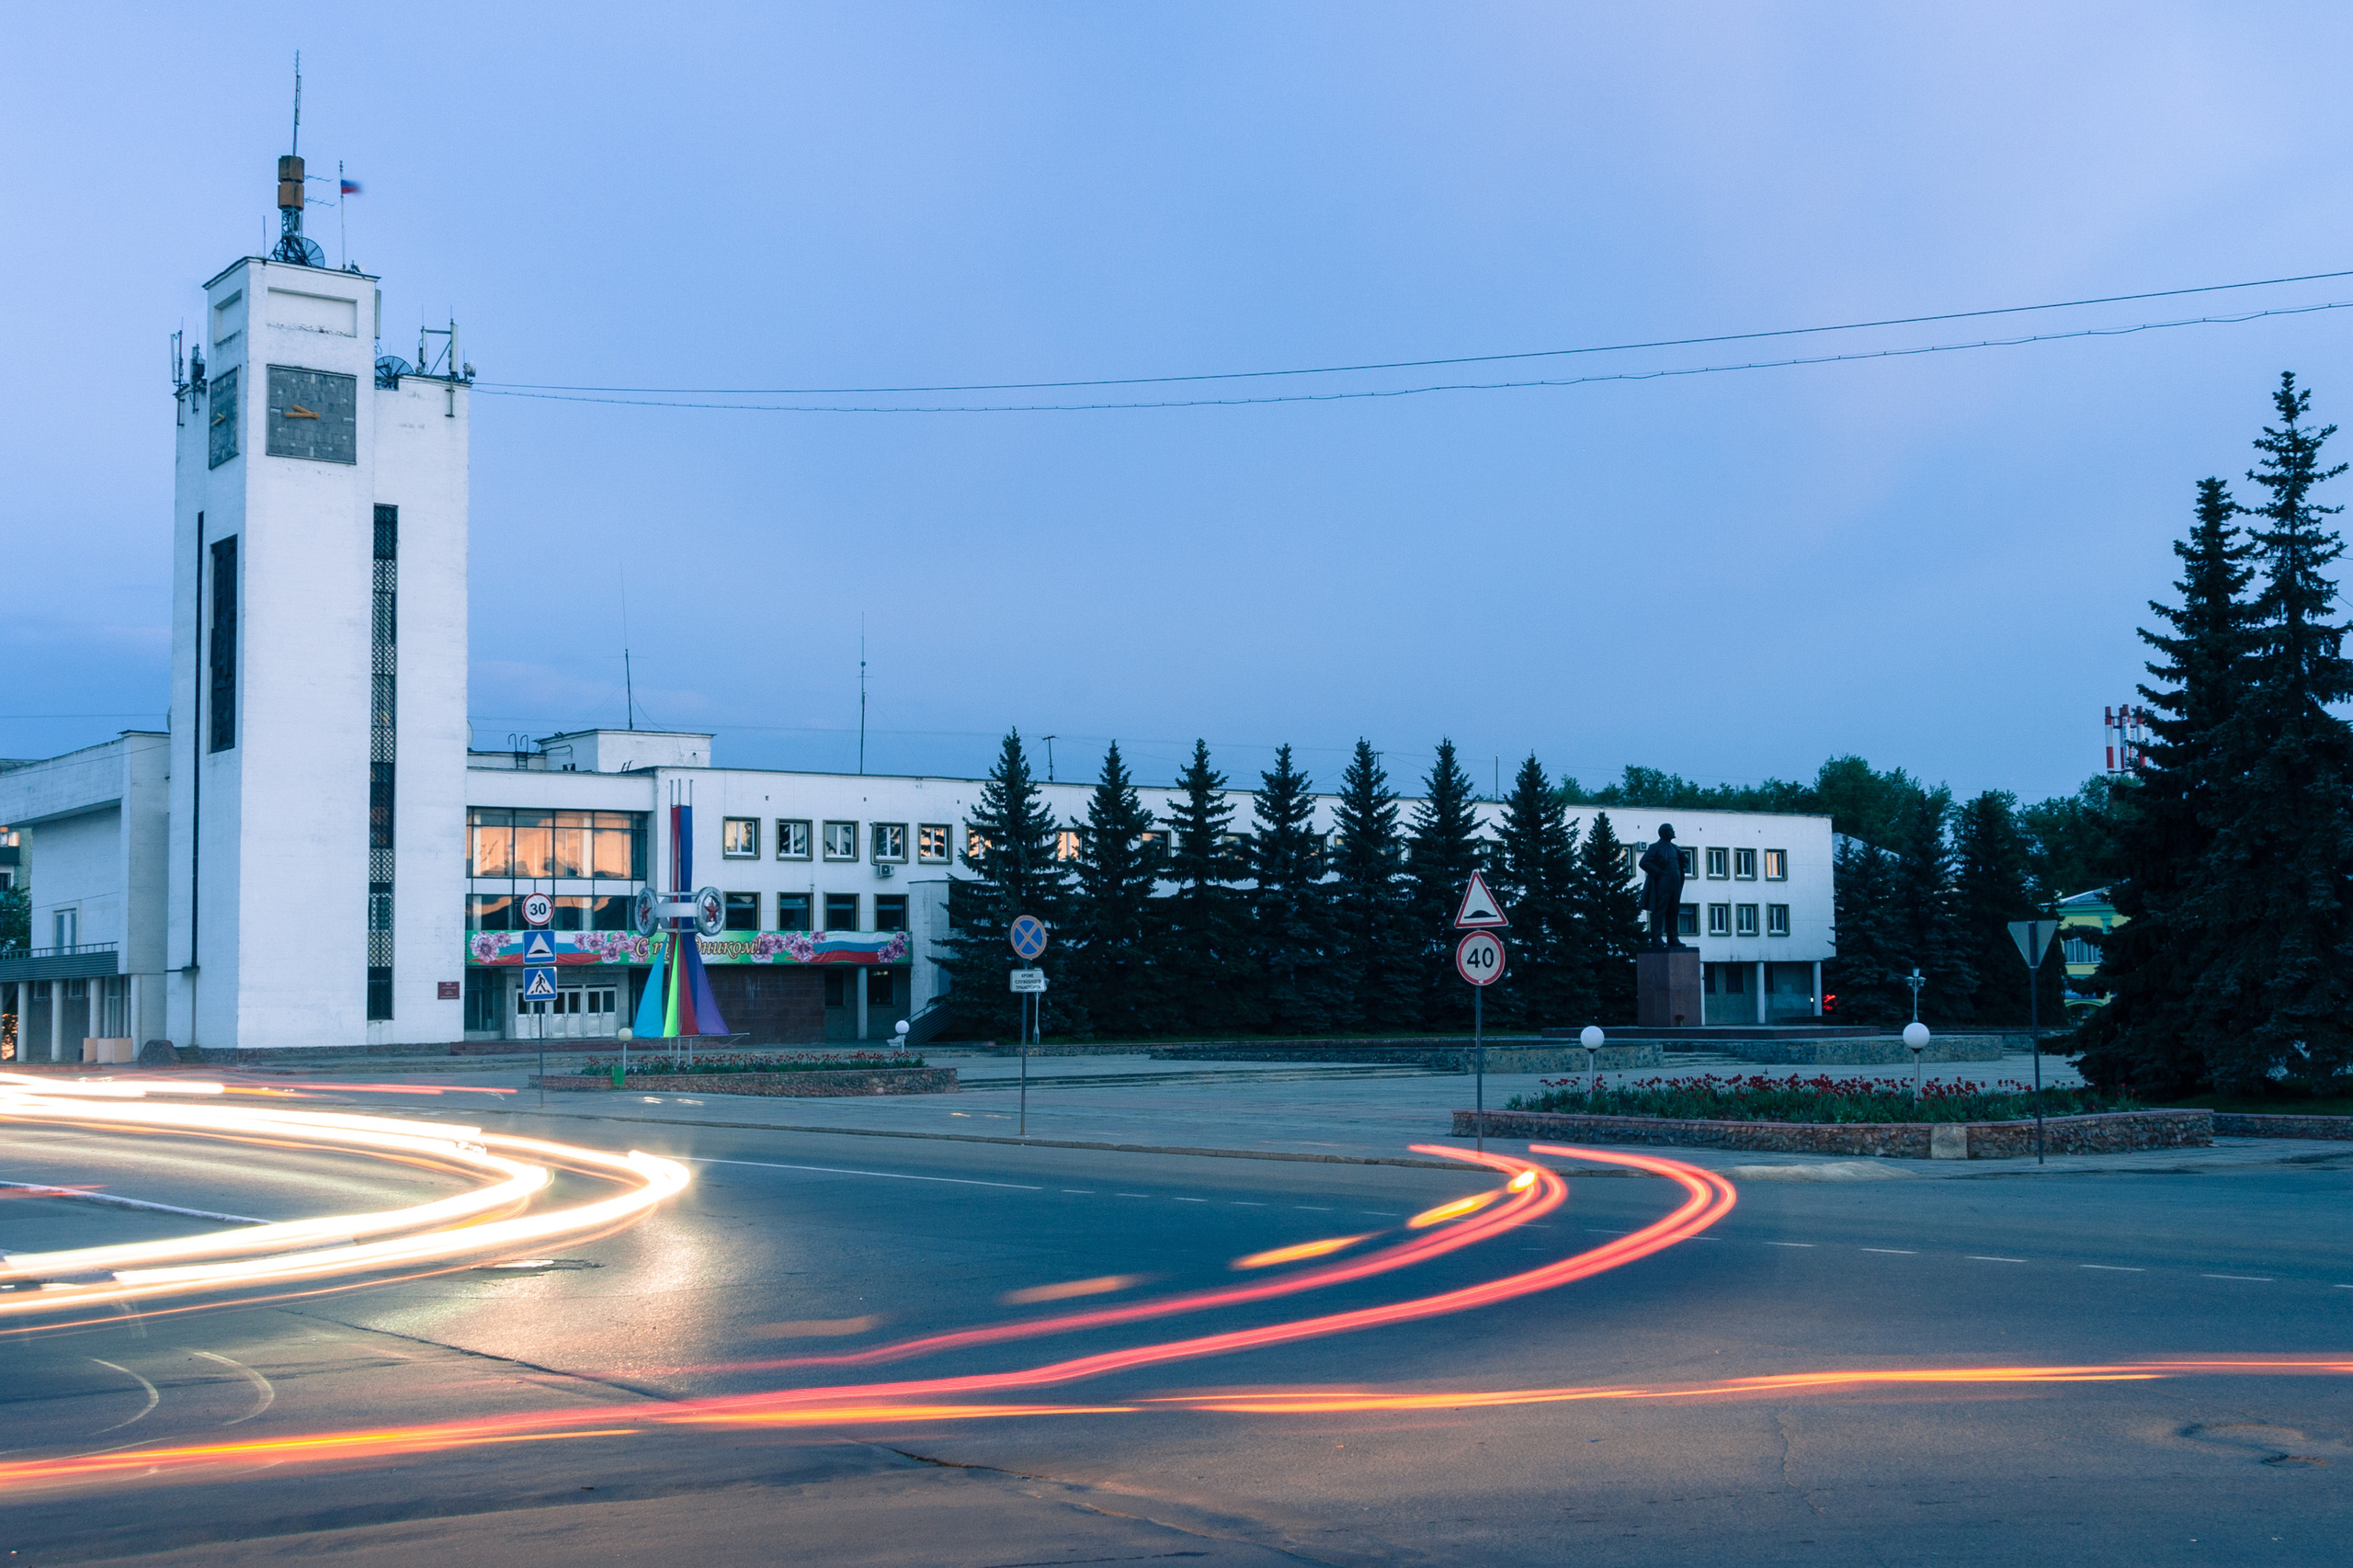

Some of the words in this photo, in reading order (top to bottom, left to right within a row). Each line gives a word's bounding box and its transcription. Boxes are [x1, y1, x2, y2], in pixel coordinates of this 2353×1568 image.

[529, 902, 547, 916] 30
[635, 937, 650, 958] С
[1467, 947, 1494, 968] 40
